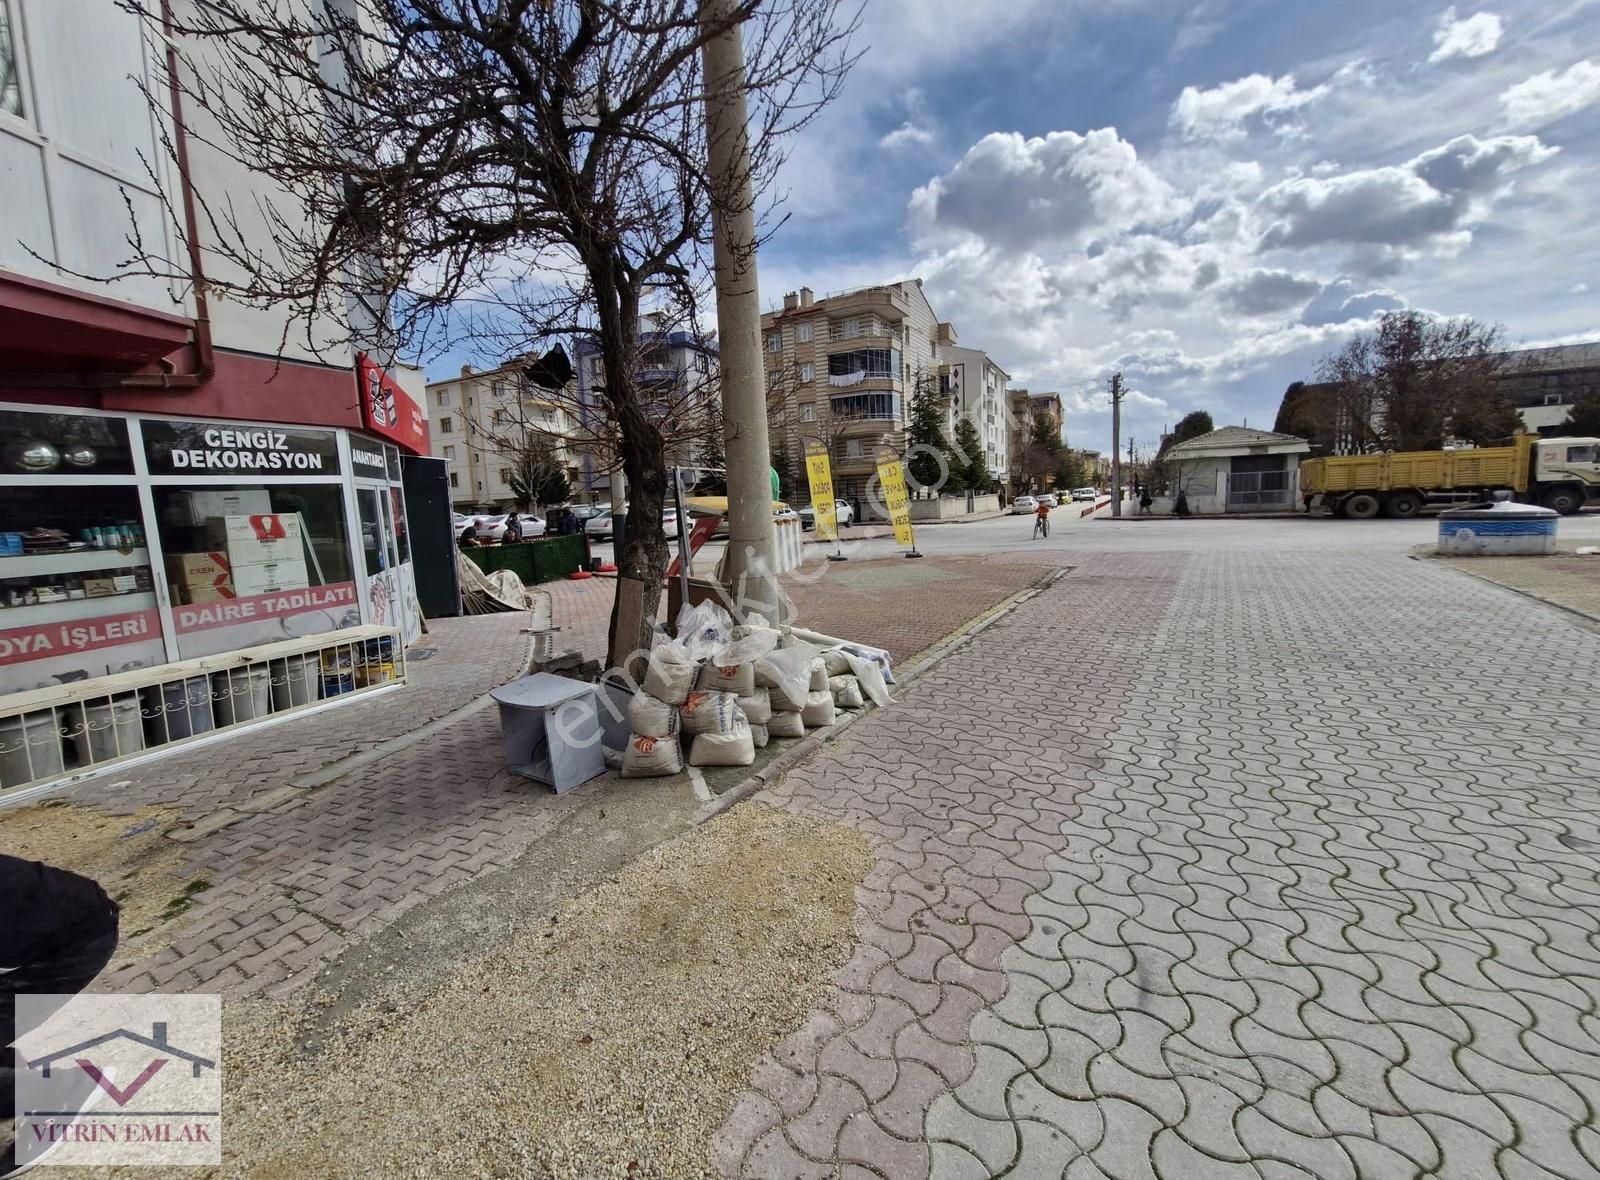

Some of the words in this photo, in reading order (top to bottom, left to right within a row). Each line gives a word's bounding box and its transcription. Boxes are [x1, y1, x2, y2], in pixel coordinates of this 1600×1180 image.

[204, 429, 289, 450] CENGİZ
[171, 449, 323, 469] DEKORASYON
[352, 448, 385, 468] ANAHTARCI
[179, 603, 257, 628] DAİRE
[262, 586, 354, 613] TADİLATI
[60, 614, 148, 649] İŞLERİ
